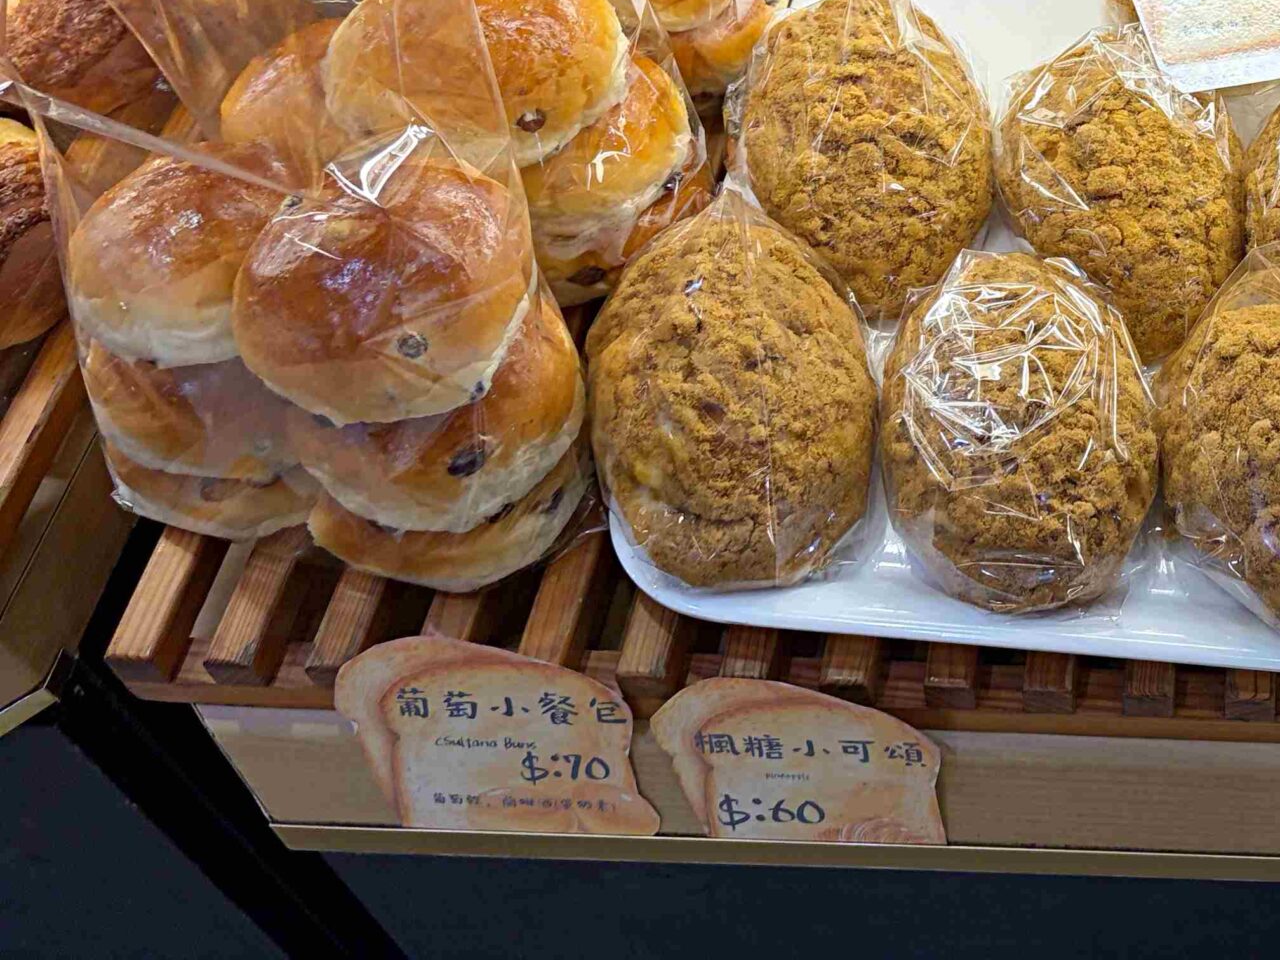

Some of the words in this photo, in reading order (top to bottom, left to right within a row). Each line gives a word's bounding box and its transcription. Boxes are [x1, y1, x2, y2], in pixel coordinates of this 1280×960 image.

[396, 687, 627, 725] 葡萄小餐包
[694, 731, 927, 767] 楓糖小可頌
